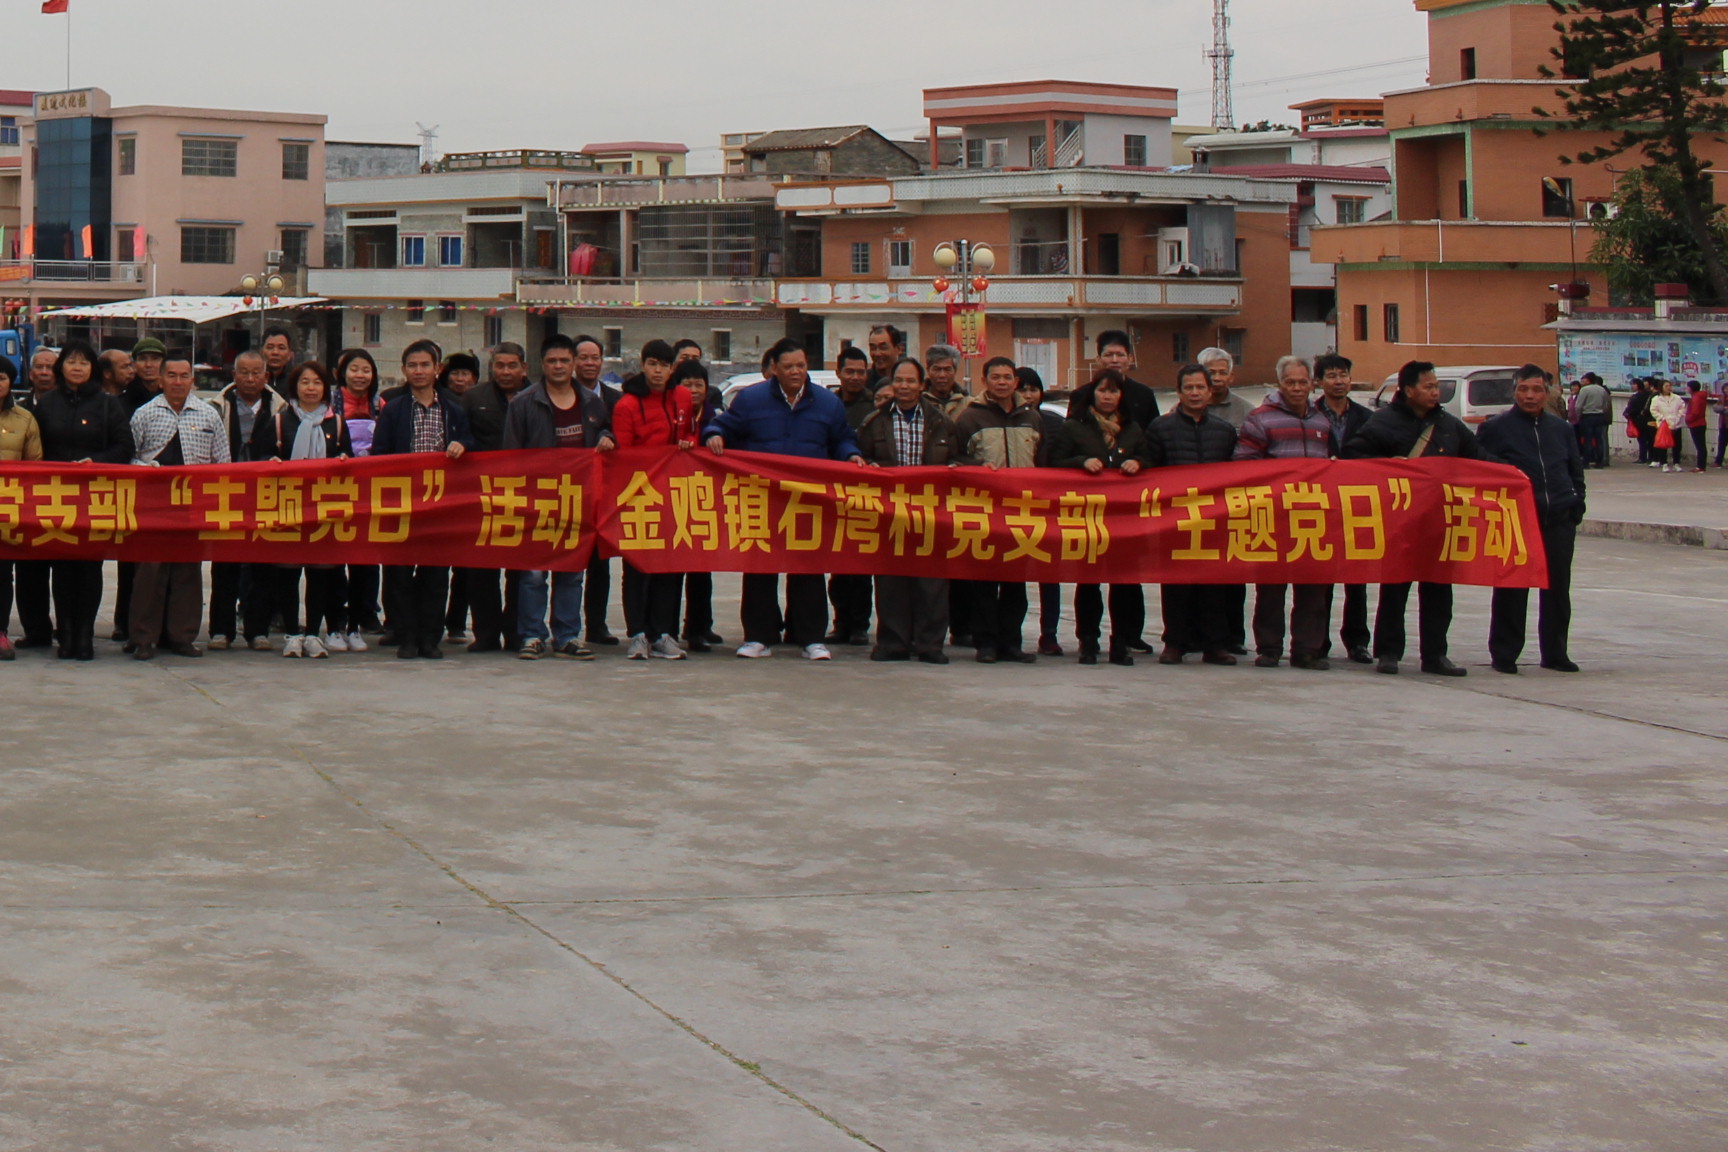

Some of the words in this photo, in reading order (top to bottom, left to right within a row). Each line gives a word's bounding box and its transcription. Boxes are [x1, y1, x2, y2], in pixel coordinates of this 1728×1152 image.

[475, 474, 583, 550] 活动
[616, 470, 1110, 564] 金鸡镇石湾村党支部
[1439, 483, 1528, 566] 活动
